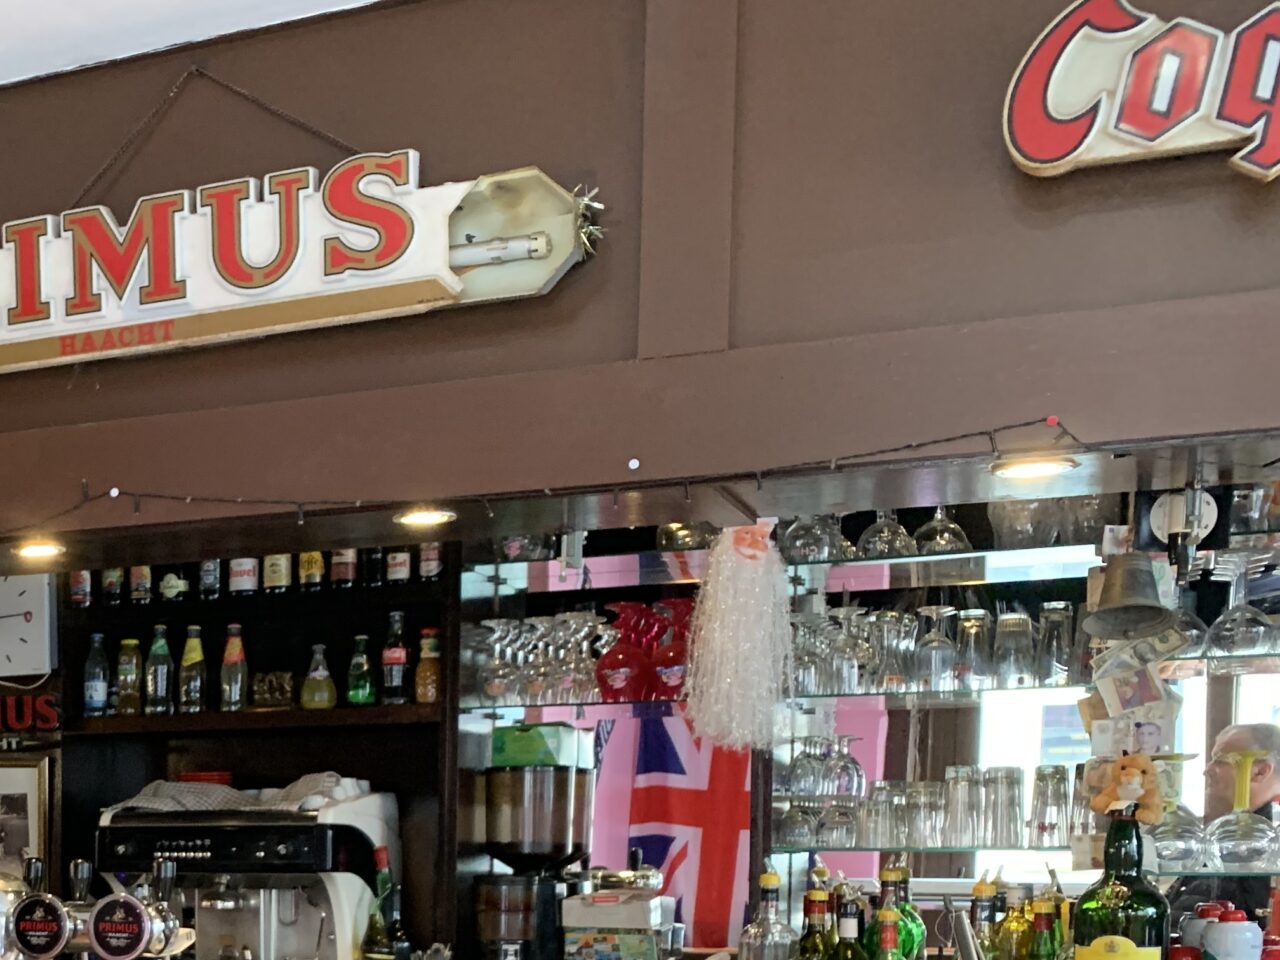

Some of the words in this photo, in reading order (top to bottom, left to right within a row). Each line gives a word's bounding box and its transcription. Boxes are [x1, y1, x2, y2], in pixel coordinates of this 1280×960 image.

[59, 319, 176, 360] HAACHT
[19, 921, 58, 932] PRIMUS
[98, 921, 139, 934] PRIMUS
